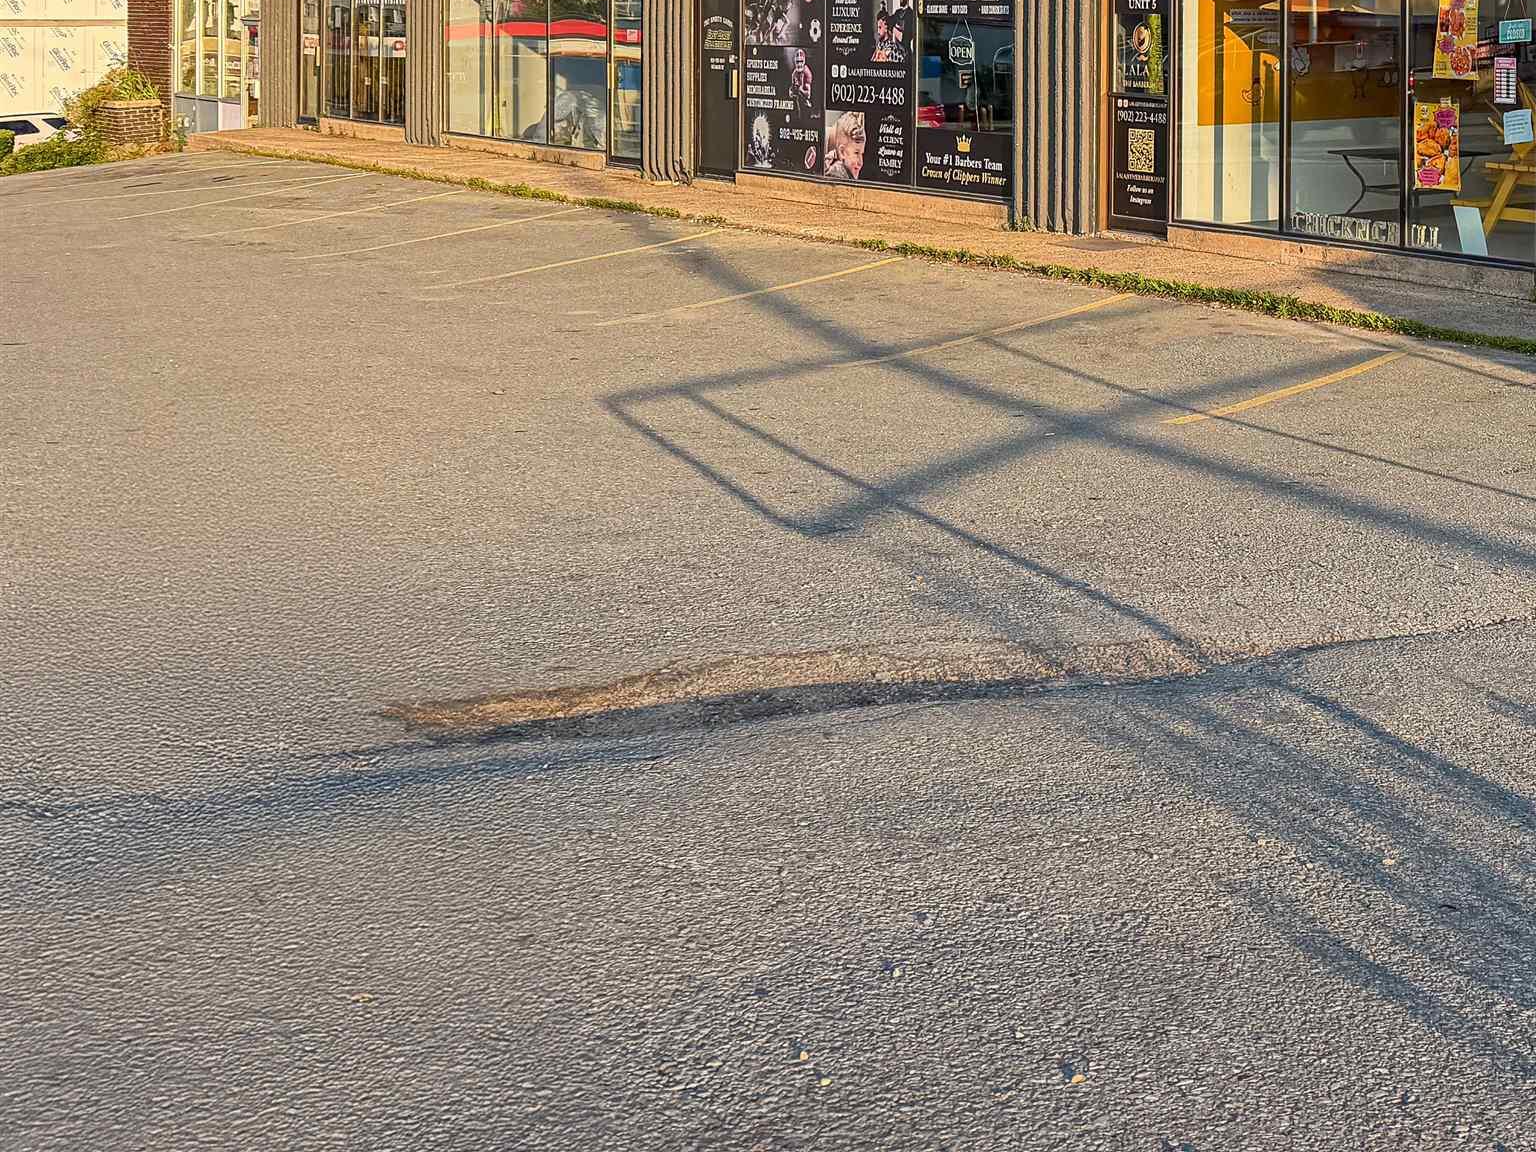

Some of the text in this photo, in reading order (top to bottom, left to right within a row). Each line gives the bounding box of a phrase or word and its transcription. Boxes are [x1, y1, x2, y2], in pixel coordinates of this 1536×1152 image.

[1128, 0, 1157, 10] UNIT 5
[832, 7, 860, 17] LUXURY
[831, 23, 862, 33] EXPERIENCE
[951, 47, 973, 58] OPEN
[831, 83, 905, 105] (902) 223-4488
[1117, 110, 1167, 124] (902) 223-4488
[878, 158, 903, 168] FAMILY
[925, 152, 1003, 171] Your #1 Barbers Team
[922, 166, 1007, 186] Crown of Clippers Winner
